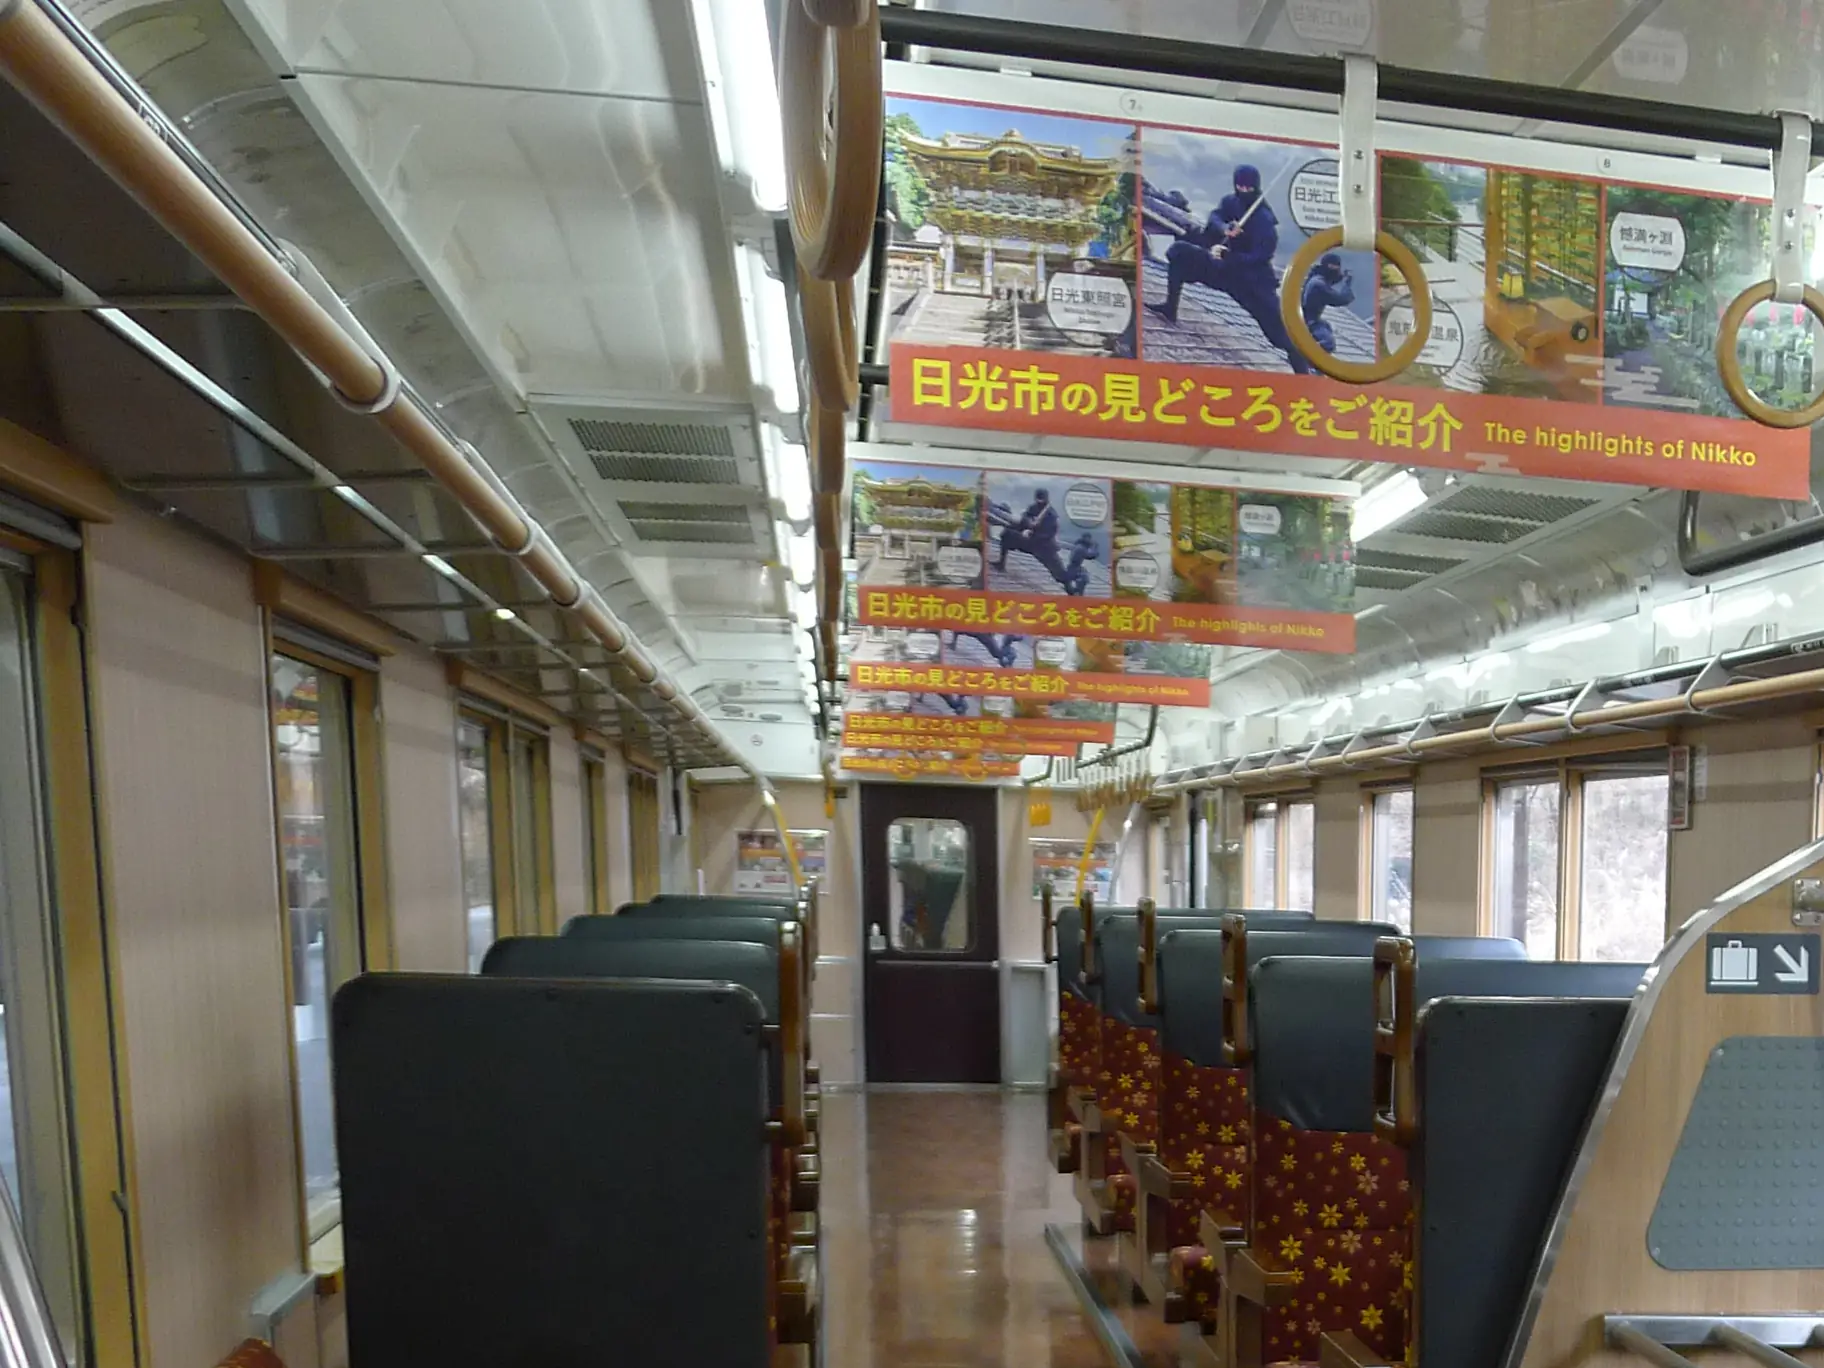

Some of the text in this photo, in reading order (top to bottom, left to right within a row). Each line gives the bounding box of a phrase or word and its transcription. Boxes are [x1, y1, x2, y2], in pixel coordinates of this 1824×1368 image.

[1051, 287, 1127, 308] 日光東照宮
[912, 357, 1463, 452] 日光市の見どころをご紹介
[1485, 422, 1758, 466] The highlights of Nikko
[868, 592, 1161, 634] 日光市の見どころをご紹介
[856, 664, 1070, 694] 日光市の見どころをご紹介
